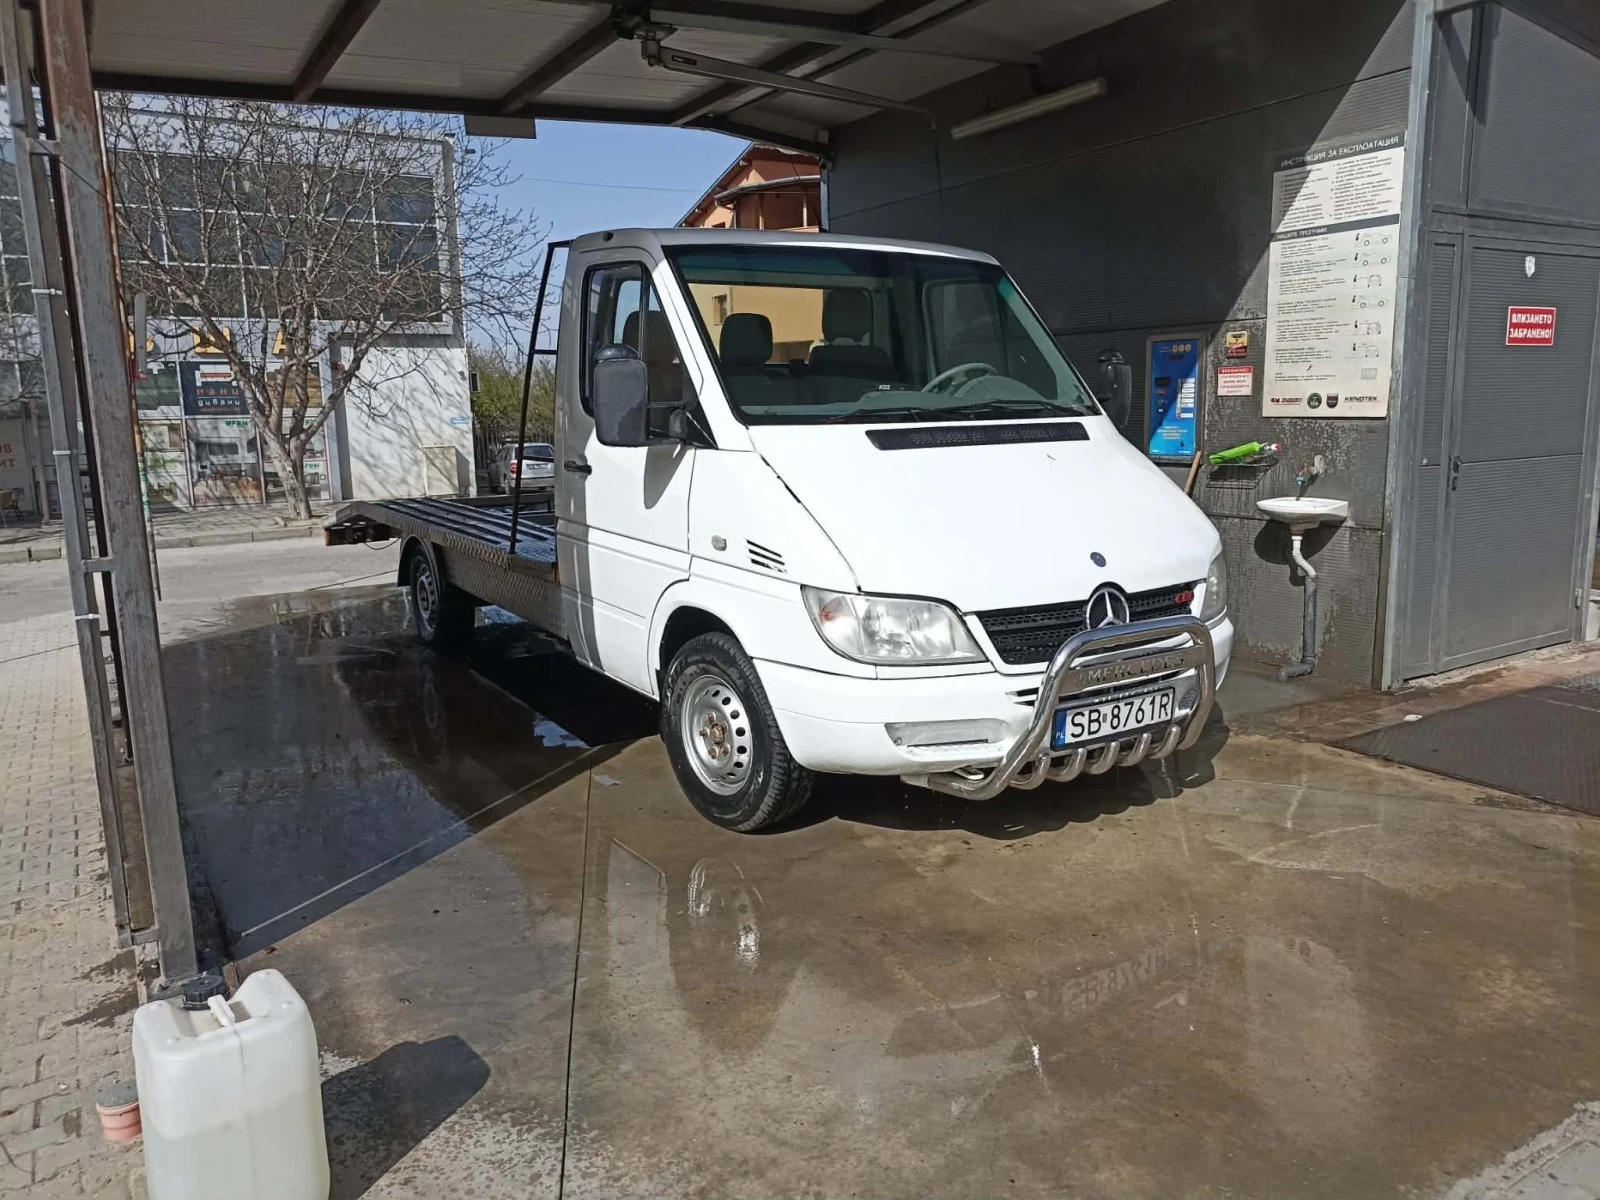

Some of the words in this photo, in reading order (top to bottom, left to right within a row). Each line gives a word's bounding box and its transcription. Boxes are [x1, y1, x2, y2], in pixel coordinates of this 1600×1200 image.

[1281, 151, 1326, 168] ИНСТРУКЦИЯ
[1327, 149, 1337, 158] ЗА
[1338, 136, 1399, 156] ЕКСПЛОАТАЦИЯ
[1509, 327, 1552, 338] ЗАБРАНЕНО!
[1512, 313, 1552, 324] ВЛИЗАНЕТО
[1087, 653, 1185, 683] MERCEDES
[1070, 708, 1102, 738] SB
[1110, 693, 1170, 730] 8761R
